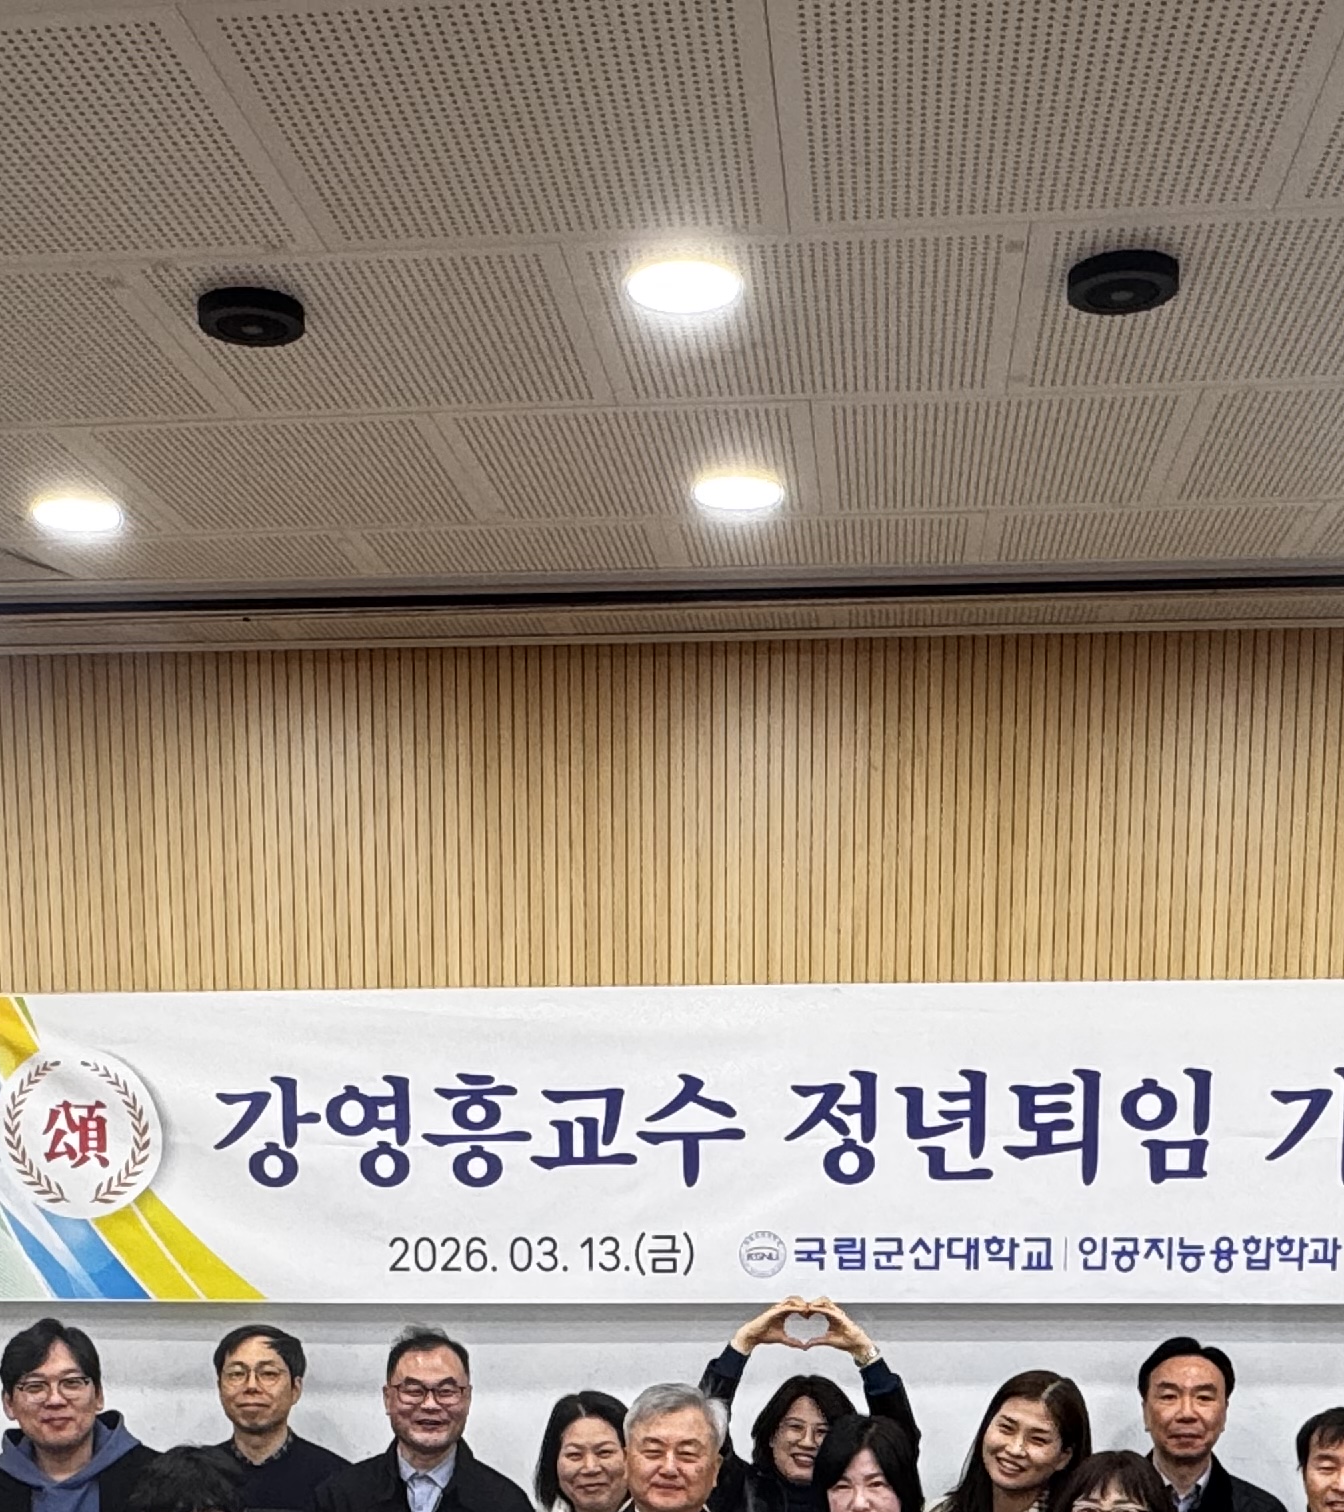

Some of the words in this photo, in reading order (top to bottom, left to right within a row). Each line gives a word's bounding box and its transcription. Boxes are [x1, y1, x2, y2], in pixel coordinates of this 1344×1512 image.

[43, 1100, 109, 1168] 頌
[213, 1073, 746, 1187] 강영흥교수
[784, 1068, 1212, 1186] 정년퇴임
[794, 1236, 1053, 1271] 국립군산대학교
[1078, 1235, 1342, 1273] 인공지능융합학과
